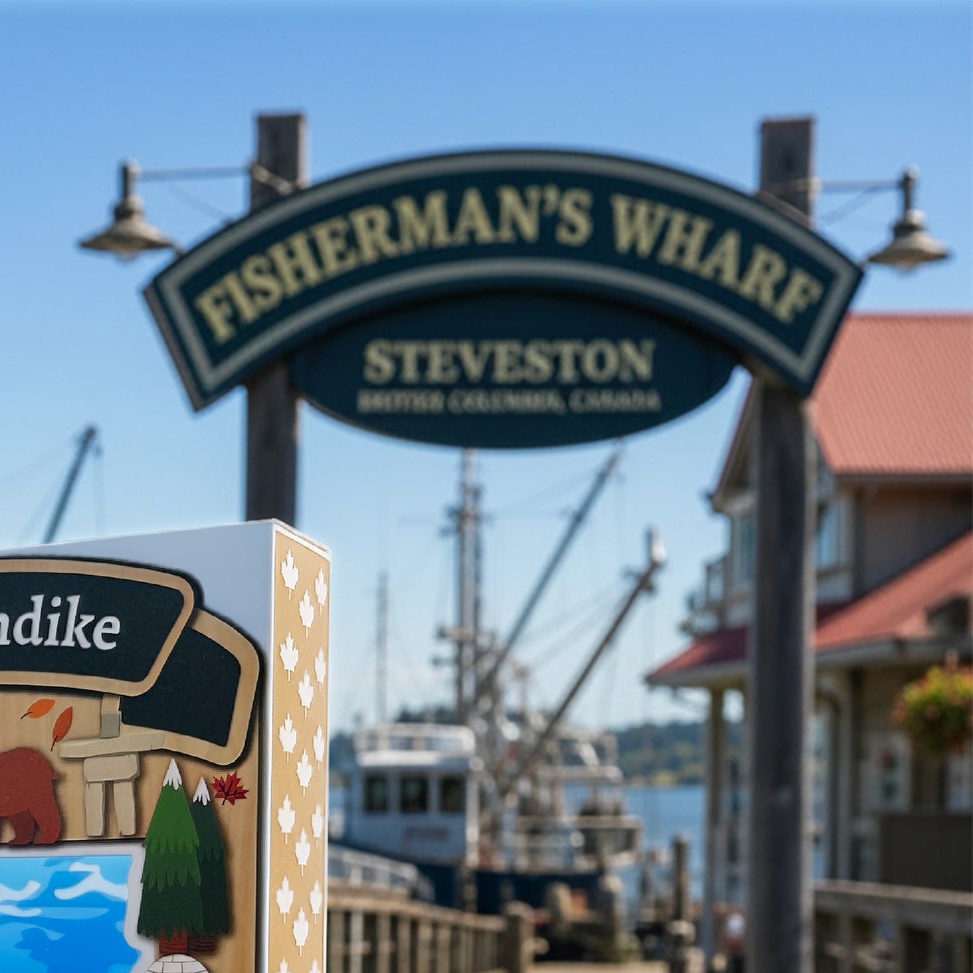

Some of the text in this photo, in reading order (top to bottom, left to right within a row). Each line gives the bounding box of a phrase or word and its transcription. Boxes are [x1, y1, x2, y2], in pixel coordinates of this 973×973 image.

[195, 184, 824, 344] FISHERMAN'S WHARF
[363, 338, 656, 384] STEVESTON
